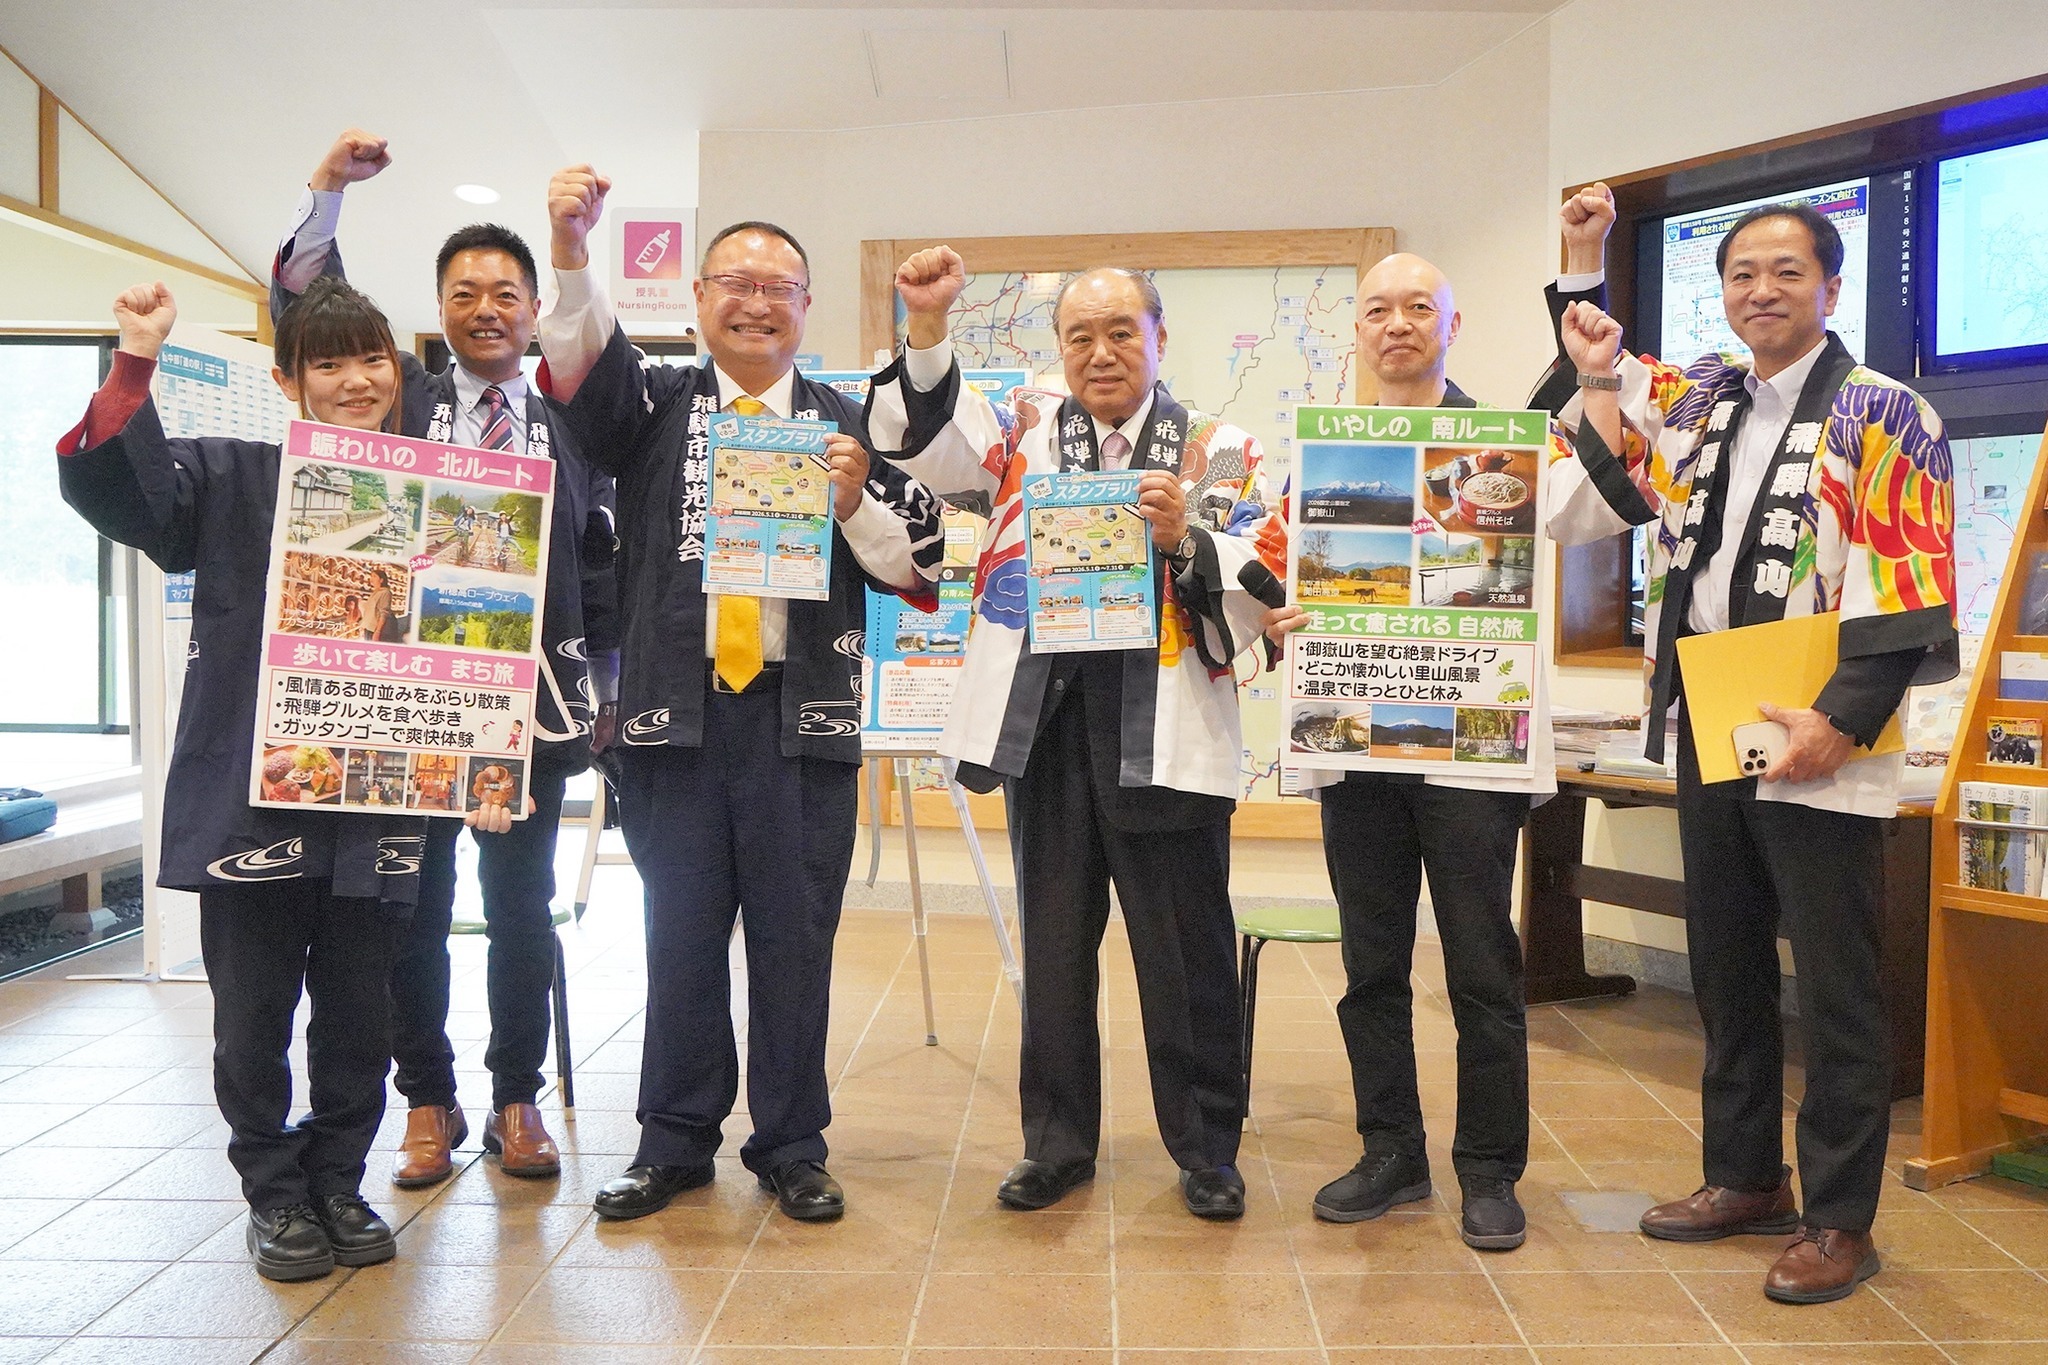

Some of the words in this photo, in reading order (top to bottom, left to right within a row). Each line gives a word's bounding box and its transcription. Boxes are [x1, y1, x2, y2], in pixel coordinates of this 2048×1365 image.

[617, 301, 687, 311] NursingRoom
[1317, 414, 1412, 438] いやしの
[1431, 416, 1527, 442] 南ルート
[310, 431, 416, 469] 賑わいの
[437, 452, 533, 487] 北ルート
[1476, 516, 1514, 525] 信州そば
[1488, 594, 1526, 604] 天然温泉
[1305, 610, 1451, 636] 走って癒される
[1459, 616, 1524, 639] 自然旅
[293, 642, 432, 676] 歩いて楽しむ
[451, 658, 514, 685] まち旅
